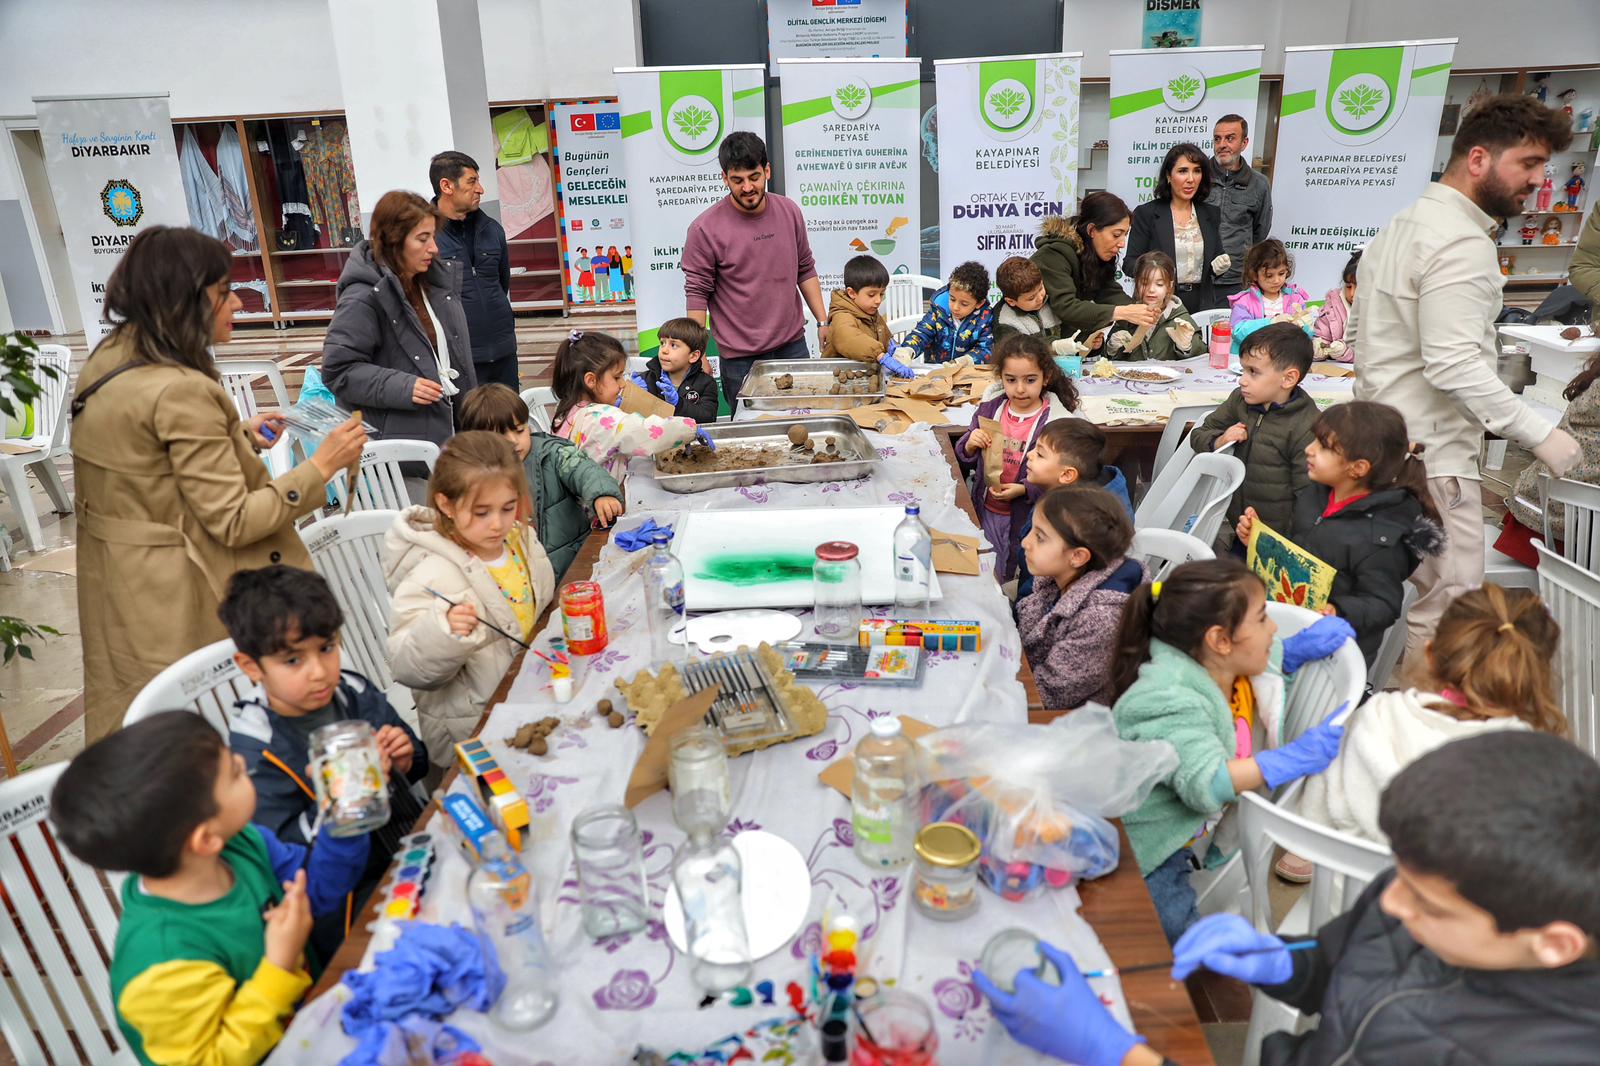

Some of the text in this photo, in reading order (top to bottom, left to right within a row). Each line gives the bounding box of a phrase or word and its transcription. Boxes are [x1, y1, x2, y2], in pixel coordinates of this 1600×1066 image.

[810, 16, 836, 26] GENÇLİK
[836, 16, 863, 25] MERKEZİ
[1155, 116, 1208, 124] KAYAPINAR
[1155, 124, 1208, 134] BELEDİYESİ
[1132, 140, 1158, 151] İKLİM
[565, 150, 609, 163] Bugünün
[975, 146, 1040, 158] KAYAPINAR
[1300, 152, 1407, 163] KAYAPINAR BELEDİYESİ
[975, 157, 1040, 170] BELEDİYESİ
[1127, 156, 1151, 164] SIFIR
[566, 165, 609, 177] Gençleri
[854, 162, 877, 170] SIFIR
[567, 177, 627, 191] GELECEĞİN
[649, 174, 696, 184] KAYAPINAR
[801, 192, 905, 206] GOGIKÊN TOVAN
[970, 192, 1008, 203] ORTAK
[952, 201, 1063, 219] DÜNYA İÇİN
[1291, 225, 1318, 236] İKLİM
[977, 233, 1035, 251] SIFIR ATIK
[1284, 241, 1309, 250] SIFIR
[1311, 242, 1334, 250] ATIK
[653, 245, 679, 257] İKLİM
[650, 262, 674, 271] SIFIR
